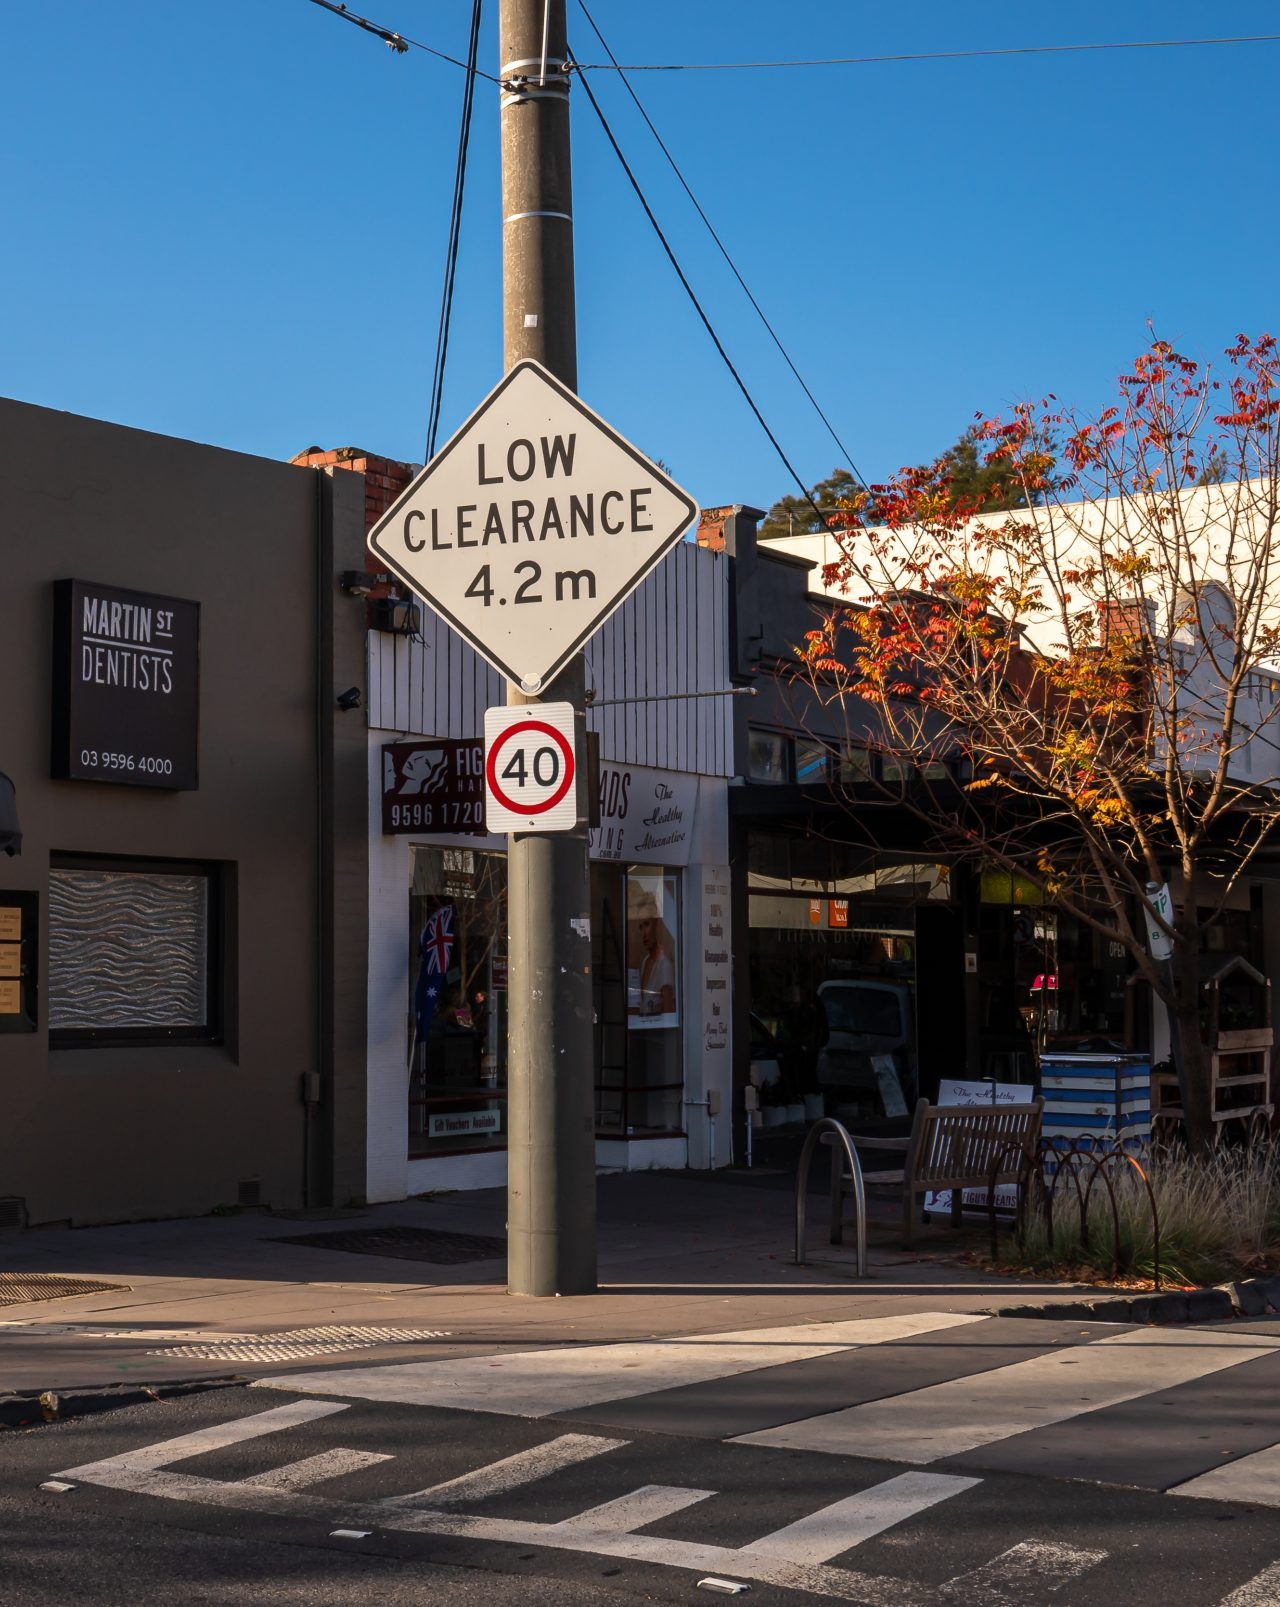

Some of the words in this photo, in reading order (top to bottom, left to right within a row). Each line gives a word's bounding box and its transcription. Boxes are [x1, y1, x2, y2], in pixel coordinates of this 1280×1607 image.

[478, 433, 576, 486] LOW
[403, 487, 654, 554] CLEARANCE
[464, 559, 543, 607] 4.2
[555, 569, 597, 601] m
[83, 596, 151, 643] MARTIN
[156, 610, 174, 631] ST
[82, 645, 173, 694] DENTISTS
[81, 750, 98, 767] 03
[102, 752, 135, 770] 9596
[138, 756, 173, 775] 4000
[456, 746, 483, 776] FIG
[501, 745, 560, 788] 40
[457, 778, 483, 793] HAI
[600, 770, 631, 820] ADS
[654, 783, 673, 801] The
[391, 803, 433, 827] 9596
[441, 801, 483, 825] 1720
[643, 805, 683, 827] Healthy
[588, 827, 624, 851] SING
